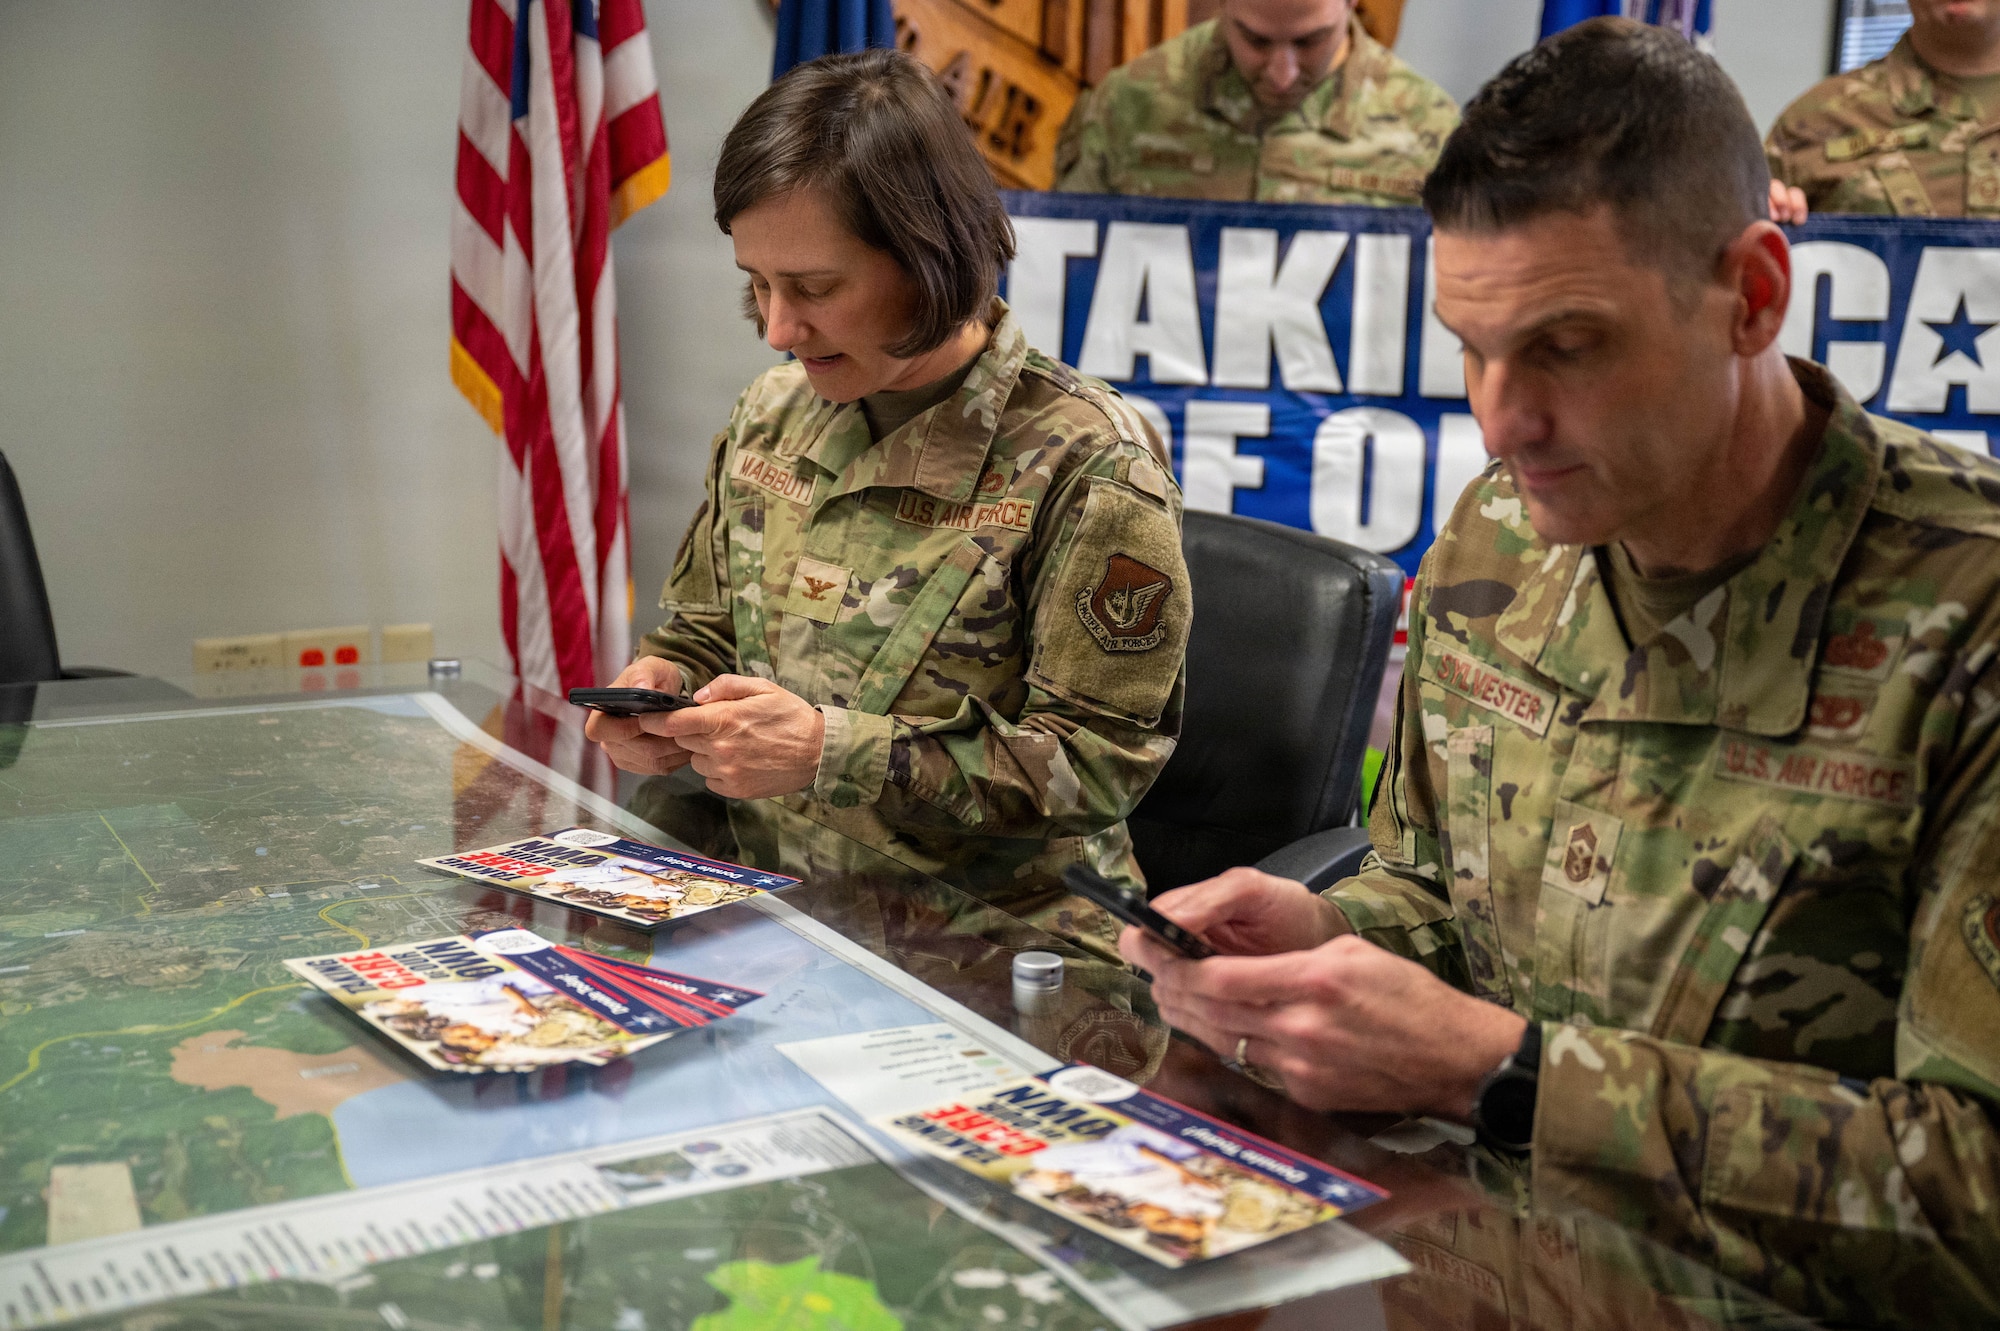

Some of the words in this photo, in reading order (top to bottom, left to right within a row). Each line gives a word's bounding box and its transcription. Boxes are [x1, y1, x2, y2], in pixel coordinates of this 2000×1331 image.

[1125, 393, 1271, 516] F
[900, 493, 935, 526] U.S.
[937, 503, 974, 528] AIR
[1078, 602, 1104, 635] PACIFIC
[1100, 635, 1118, 649] AIR
[1121, 636, 1157, 648] FORCES
[1437, 653, 1542, 724] SYLVESTER
[1776, 754, 1817, 789] AIR
[1817, 760, 1905, 802] FORCE
[436, 857, 525, 882] TAKING
[459, 851, 557, 877] CARE
[498, 849, 546, 864] OUR
[509, 840, 608, 865] OWN
[699, 864, 744, 880] Donate
[306, 957, 379, 995] TAKING
[338, 952, 427, 990] CARE
[391, 951, 440, 972] OUR
[415, 940, 505, 979] OWN
[994, 1085, 1120, 1135] OWN
[893, 1115, 1003, 1164] TAKING
[922, 1103, 1049, 1156] CARE
